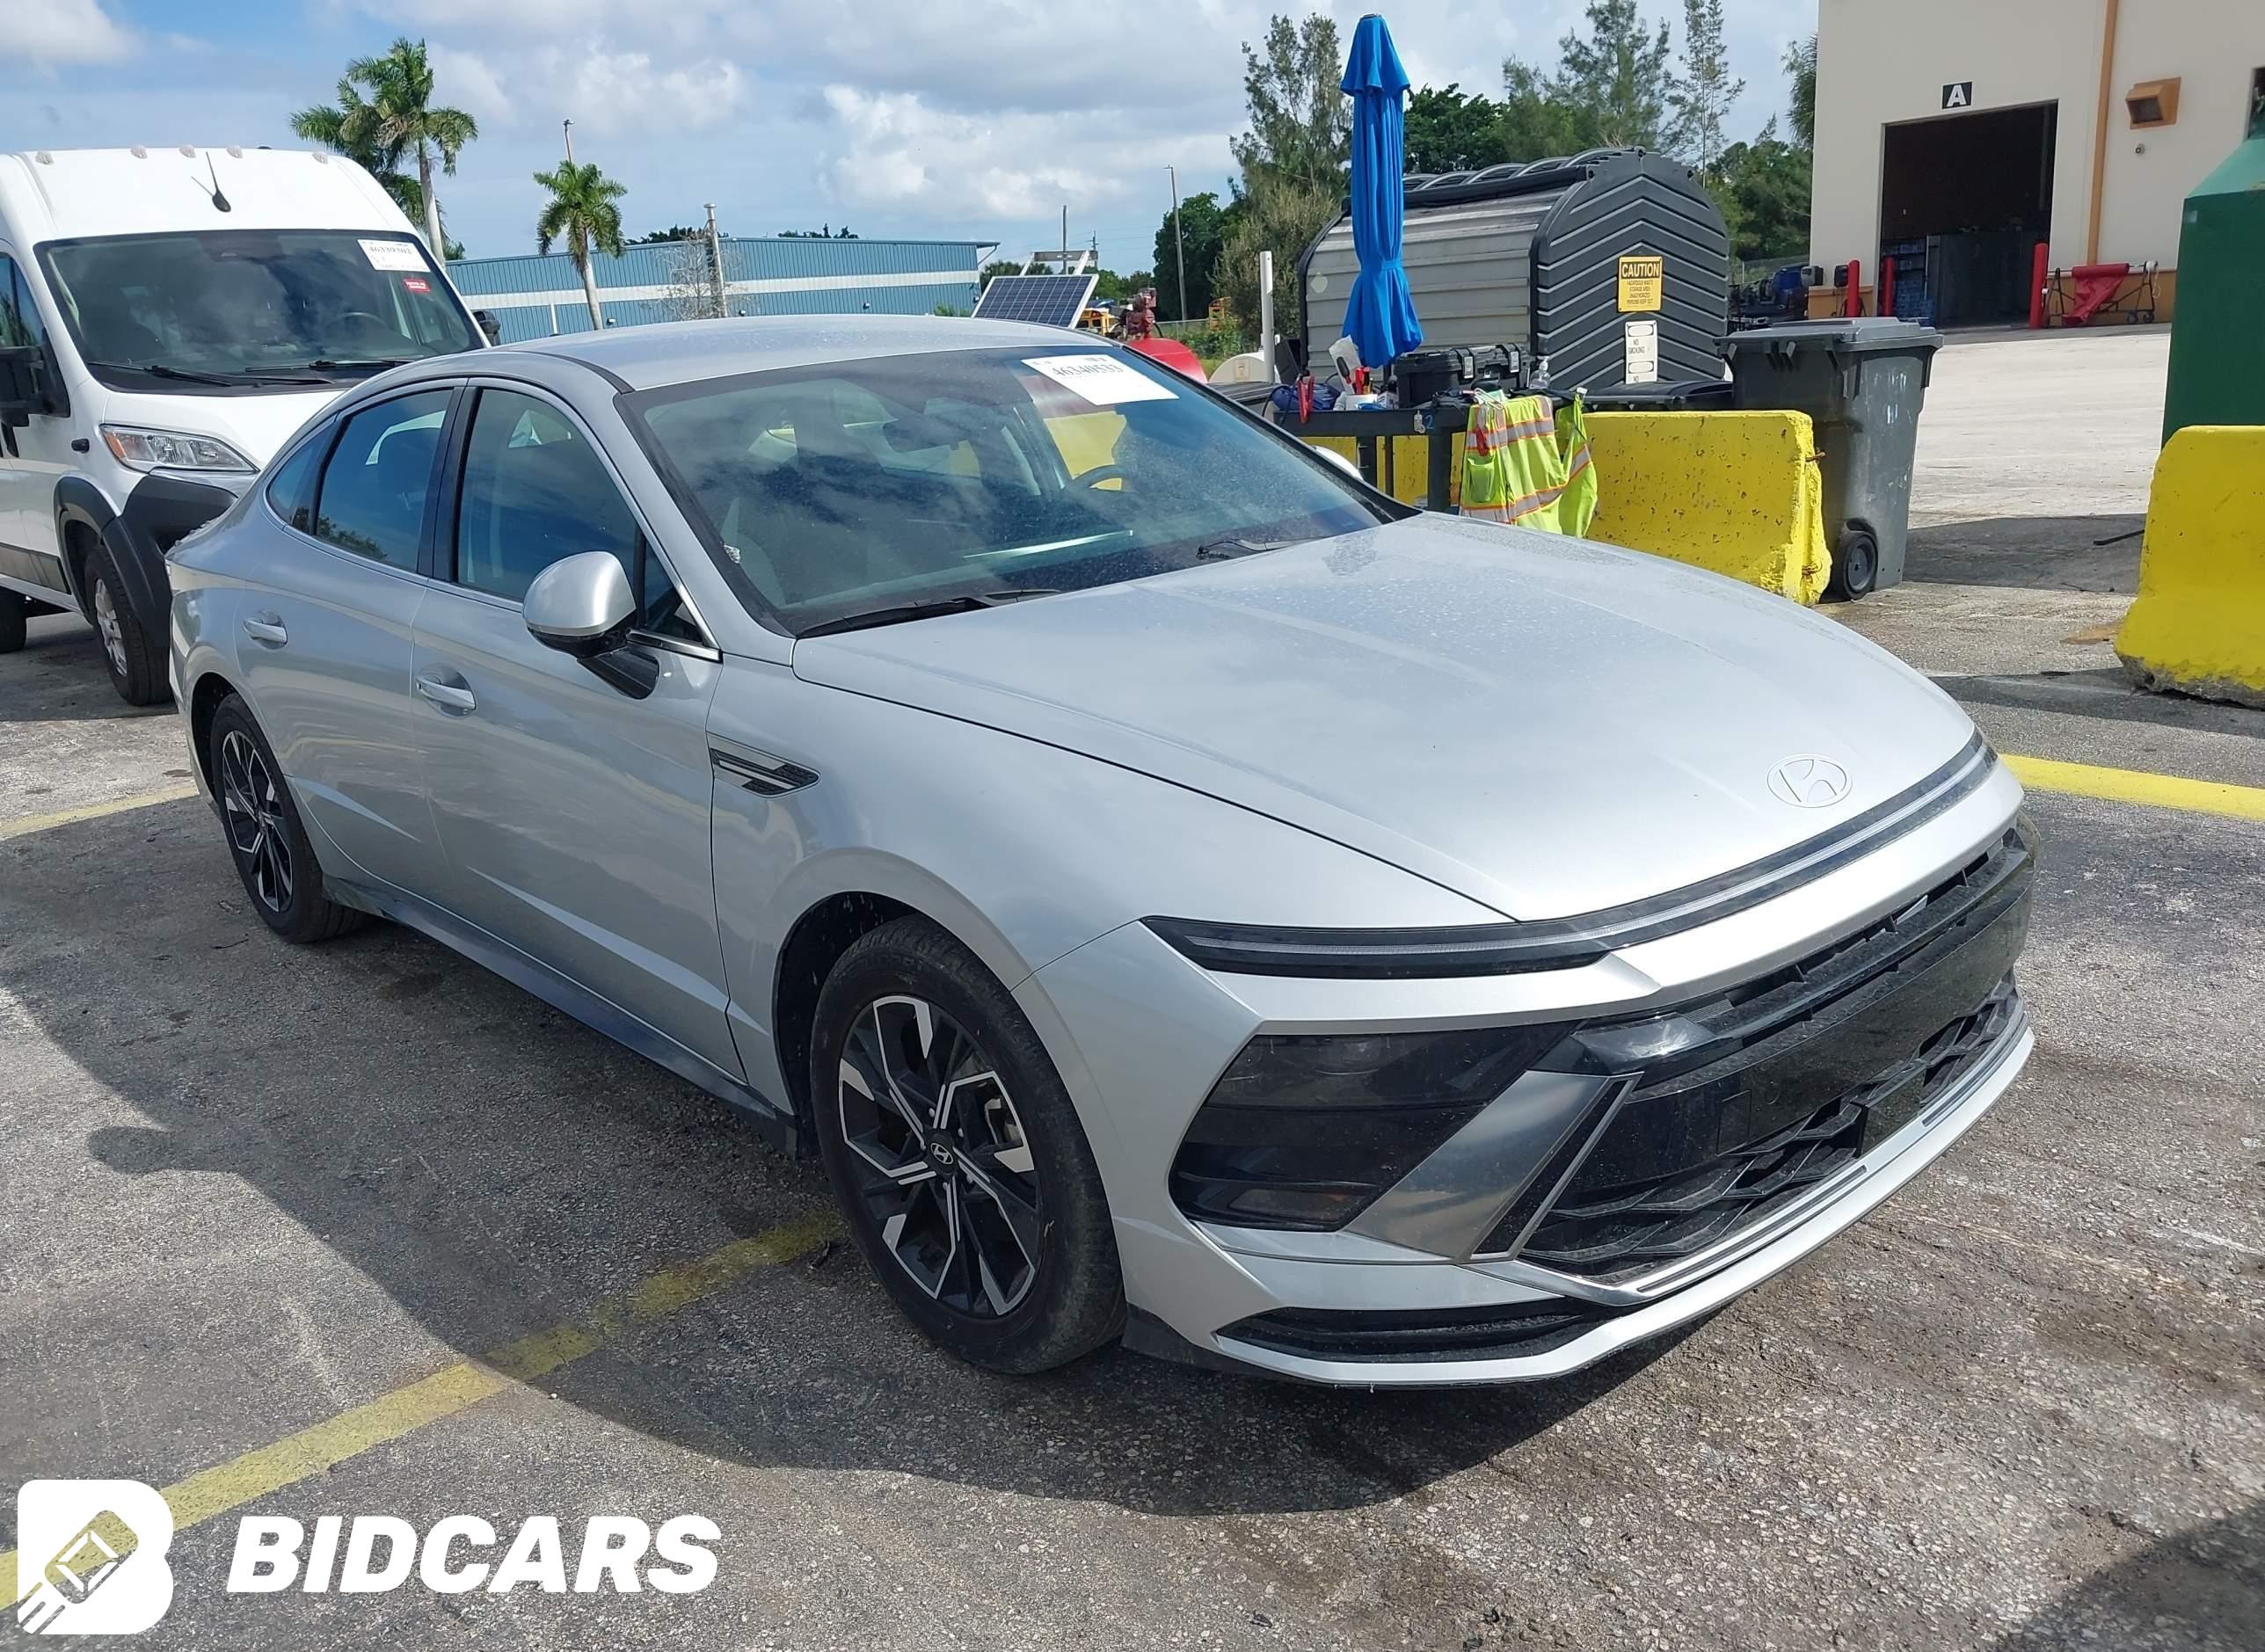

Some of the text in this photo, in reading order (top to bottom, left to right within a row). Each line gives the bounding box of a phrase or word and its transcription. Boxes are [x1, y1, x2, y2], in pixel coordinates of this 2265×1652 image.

[1947, 84, 1967, 107] A
[1621, 263, 1659, 278] CAUTION
[1424, 414, 1435, 430] 2
